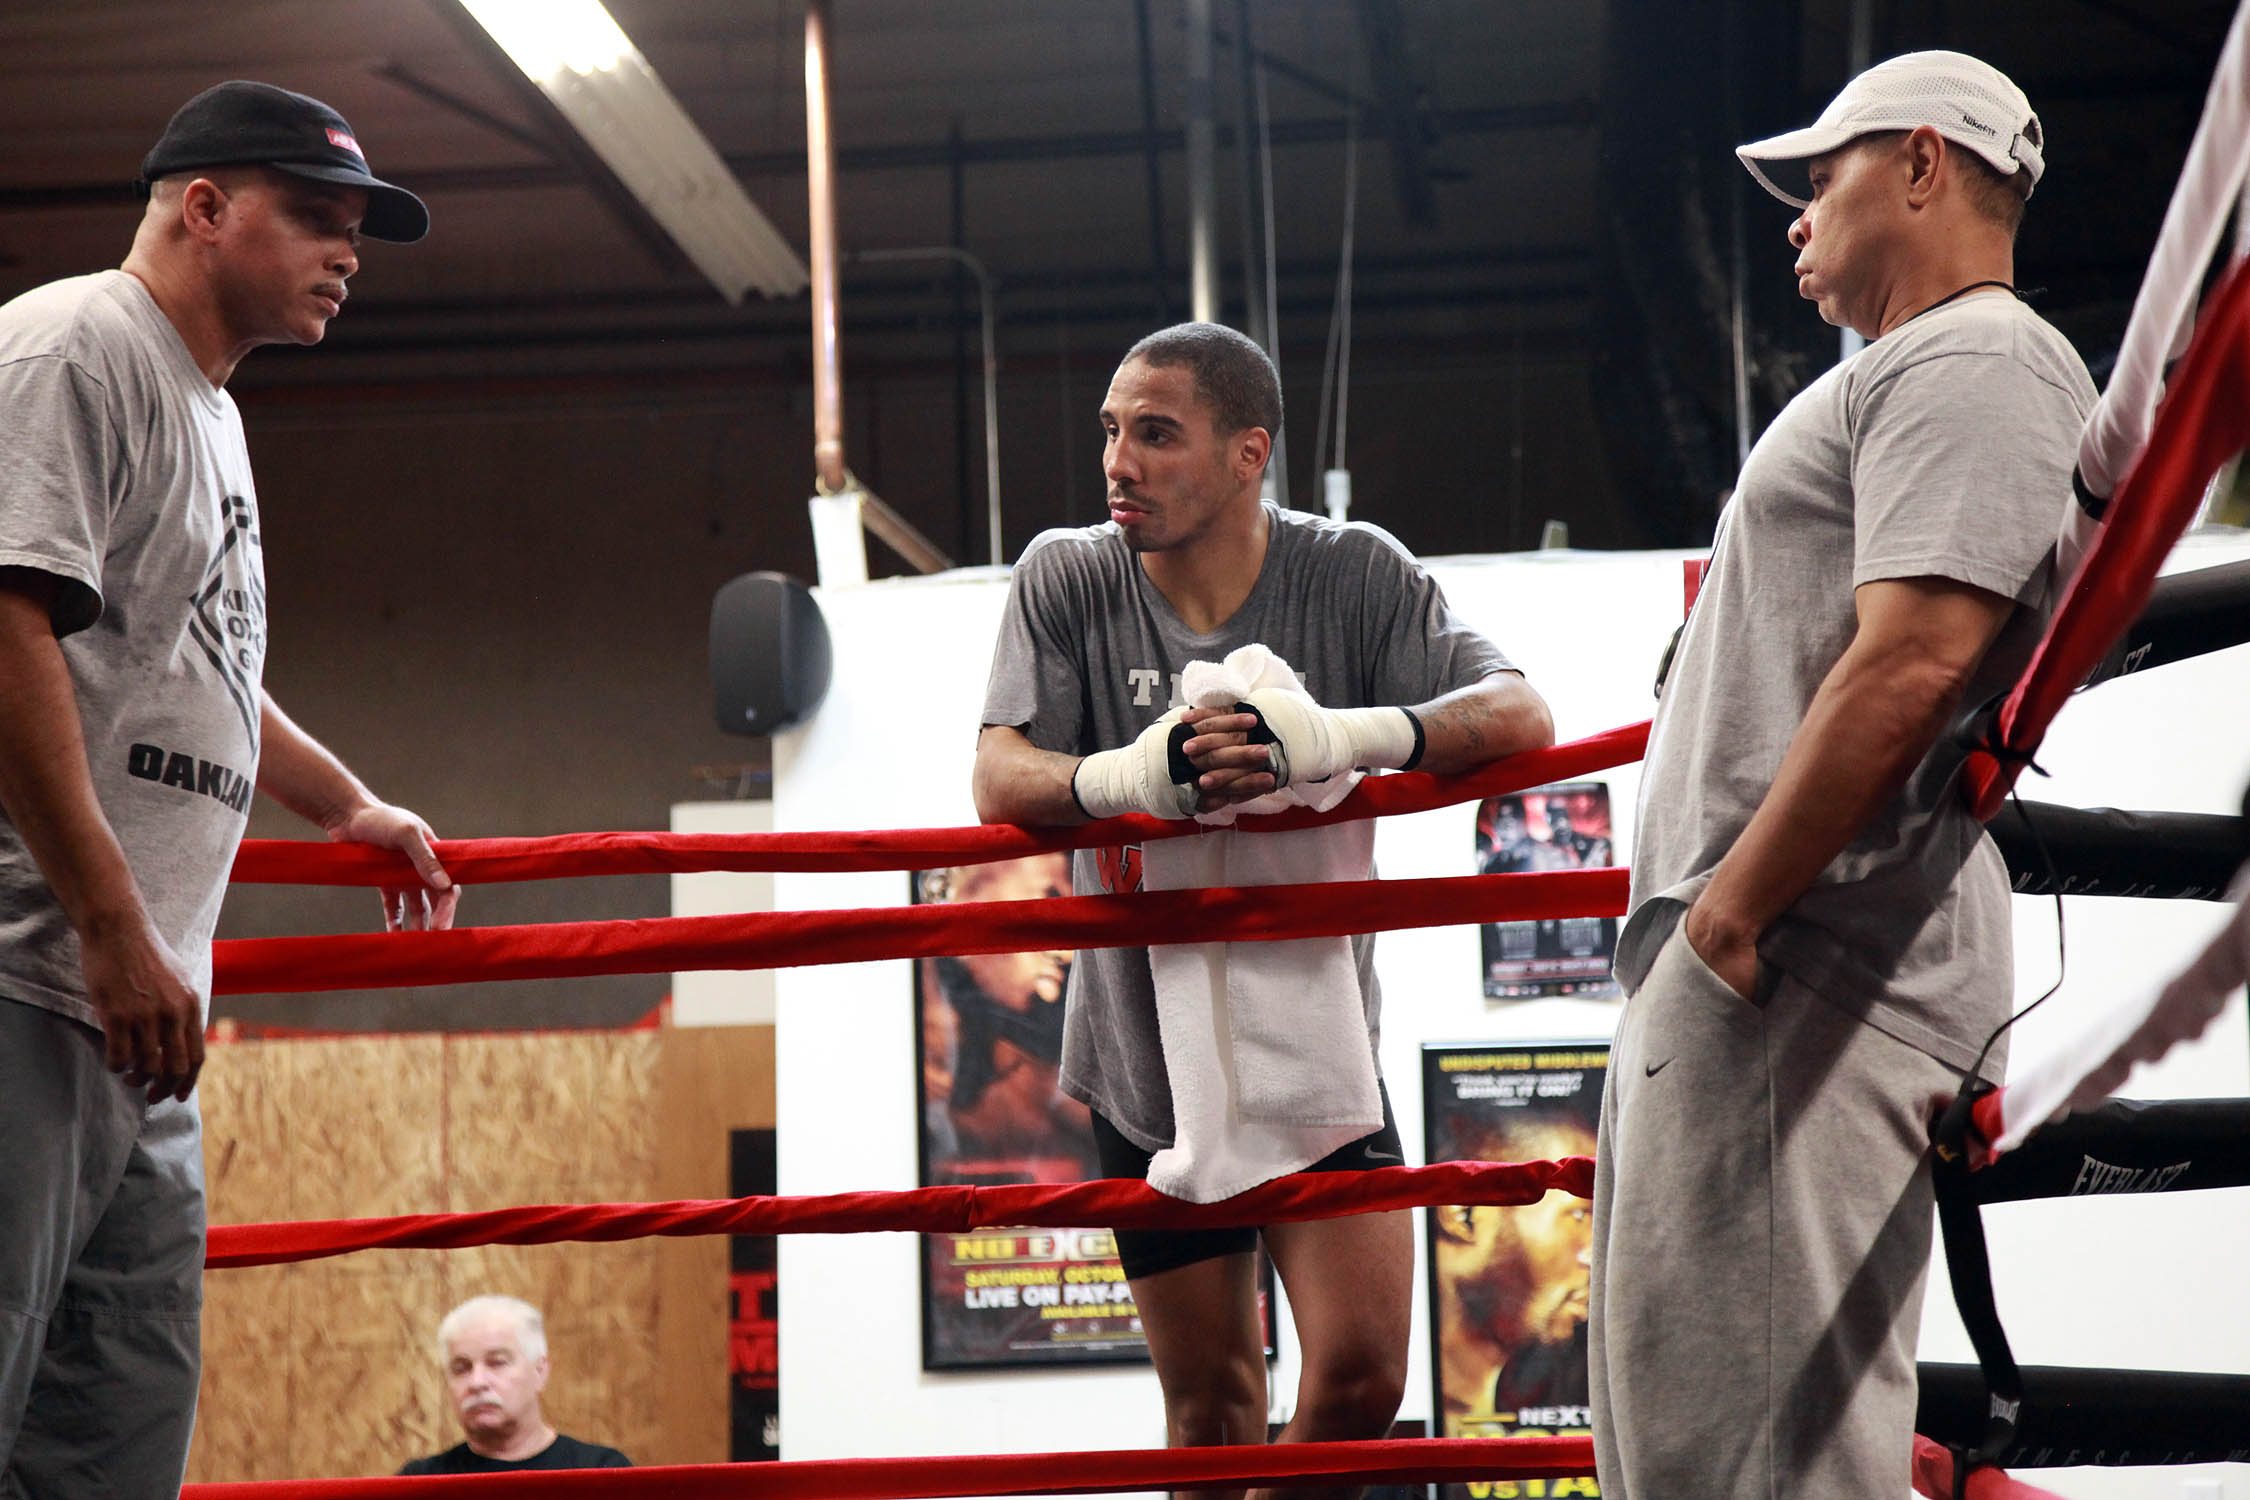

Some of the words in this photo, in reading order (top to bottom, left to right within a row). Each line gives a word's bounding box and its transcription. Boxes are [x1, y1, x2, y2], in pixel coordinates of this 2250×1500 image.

[2070, 1154, 2192, 1196] EVERLAST
[965, 1286, 1019, 1309] LIVE
[1022, 1284, 1060, 1307] ON
[1063, 1282, 1134, 1305] PAY-P
[1518, 1405, 1592, 1426] NEXT
